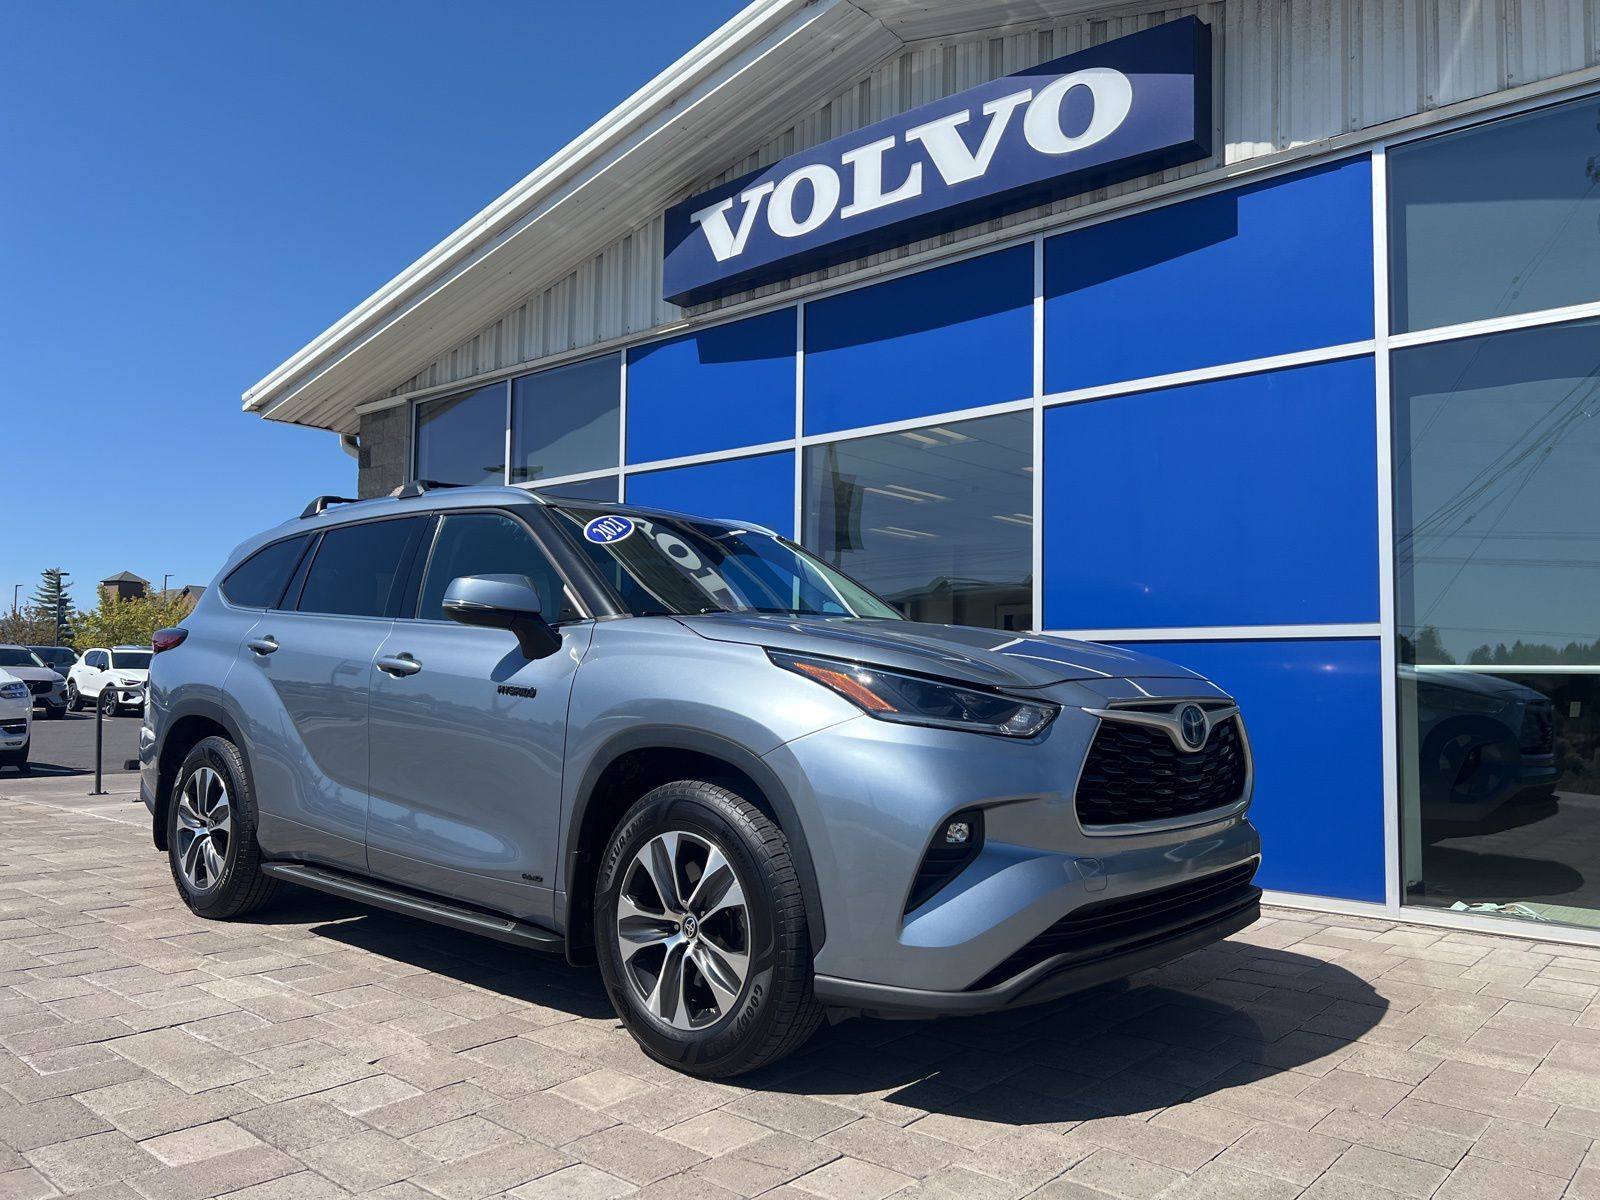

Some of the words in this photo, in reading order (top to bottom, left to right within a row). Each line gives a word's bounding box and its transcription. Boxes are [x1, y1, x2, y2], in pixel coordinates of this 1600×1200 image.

[691, 67, 1134, 263] VOLVO
[592, 517, 627, 541] 2021
[604, 811, 650, 884] ASSURAN
